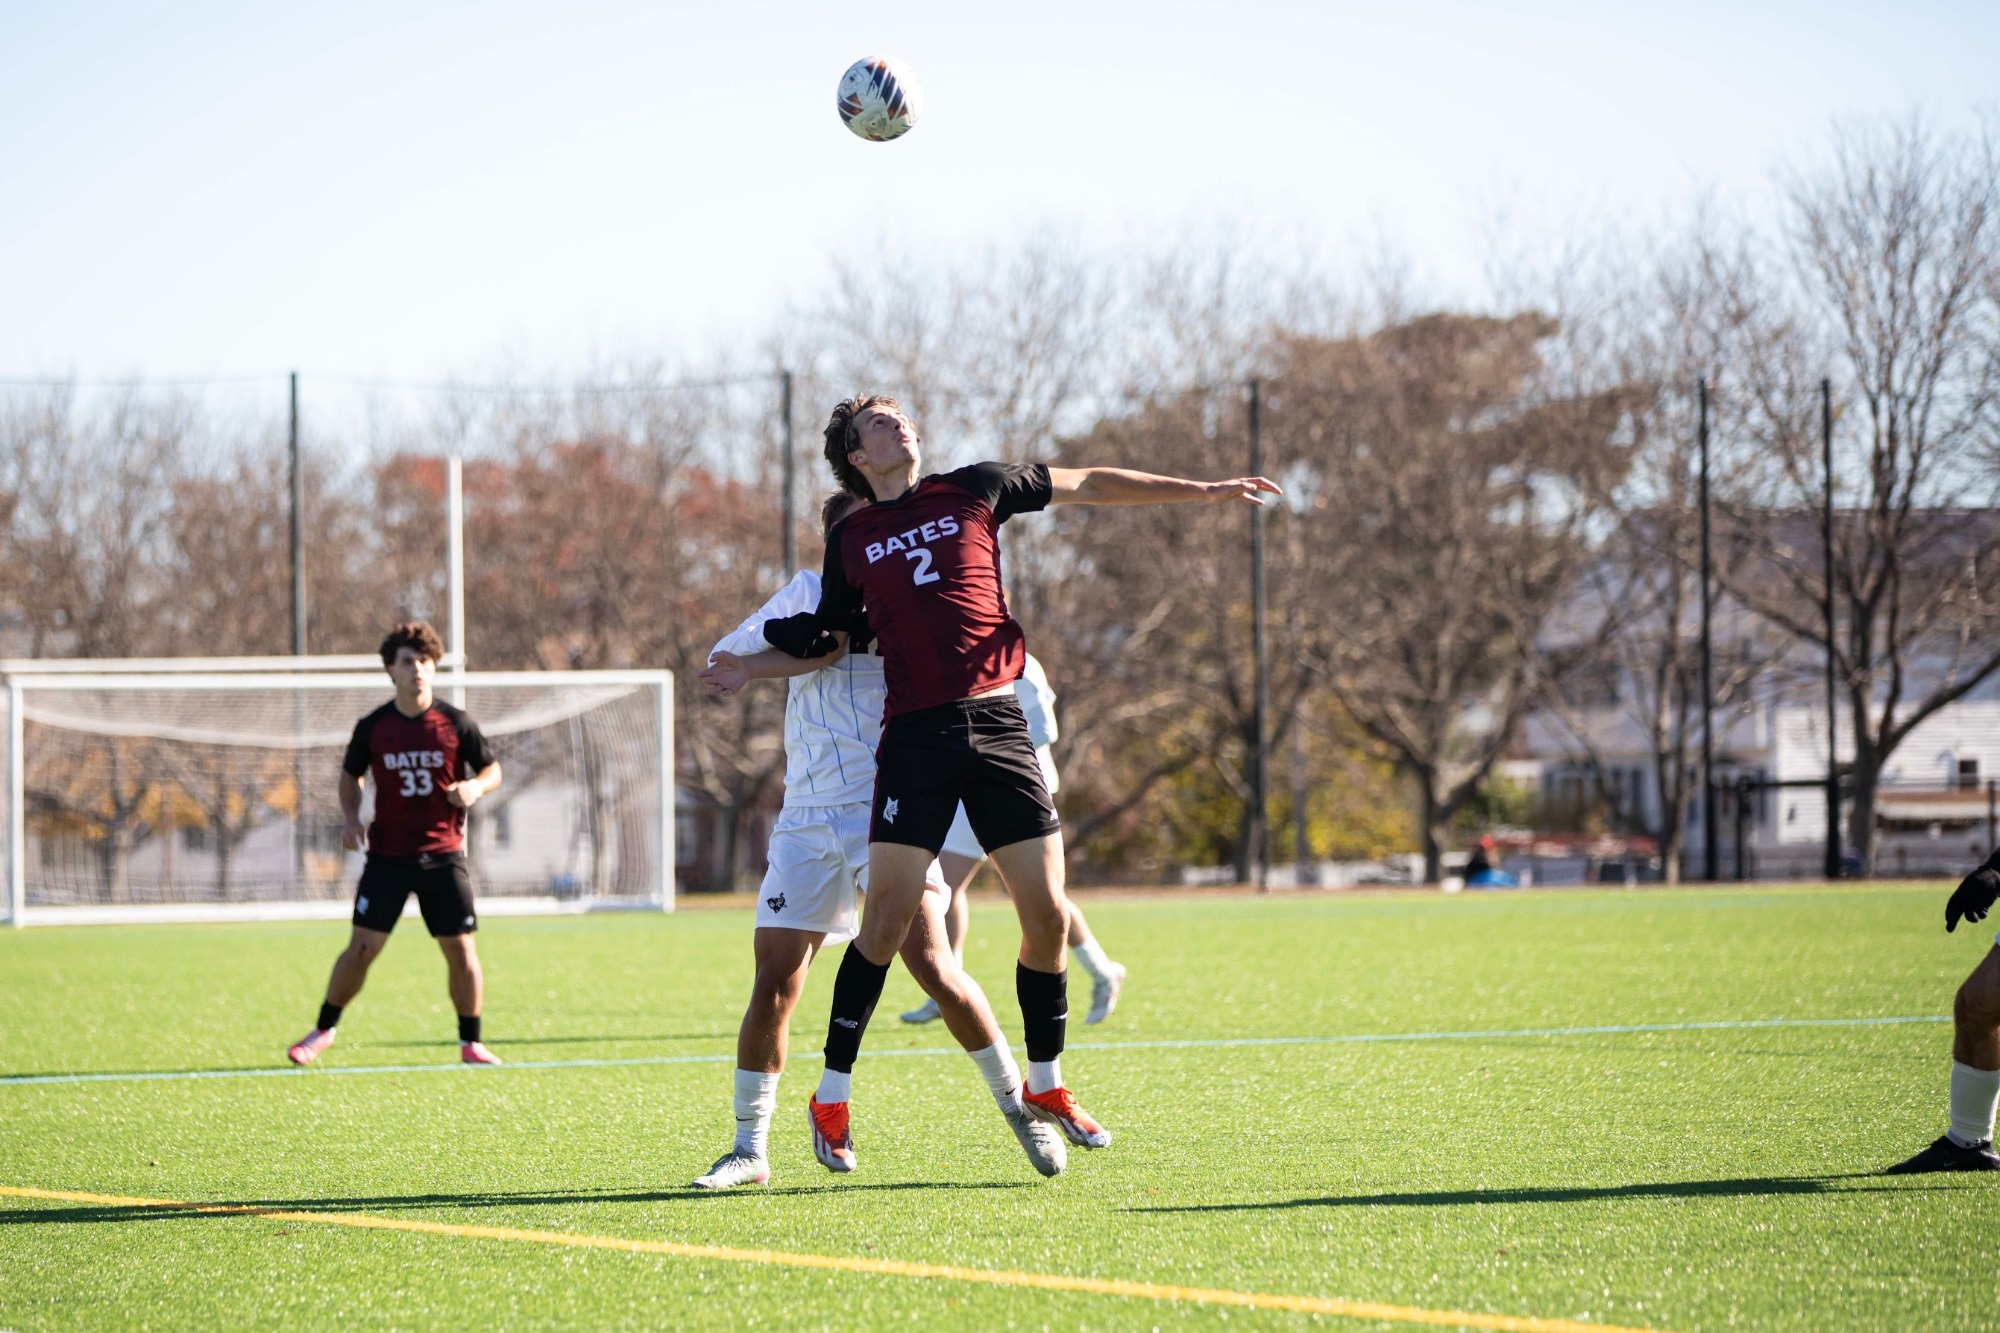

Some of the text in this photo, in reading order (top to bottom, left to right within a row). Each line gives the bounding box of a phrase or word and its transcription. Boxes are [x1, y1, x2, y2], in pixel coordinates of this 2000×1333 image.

[865, 516, 959, 564] BATES
[905, 548, 940, 586] 2
[383, 751, 444, 770] BATES
[399, 769, 433, 797] 33
